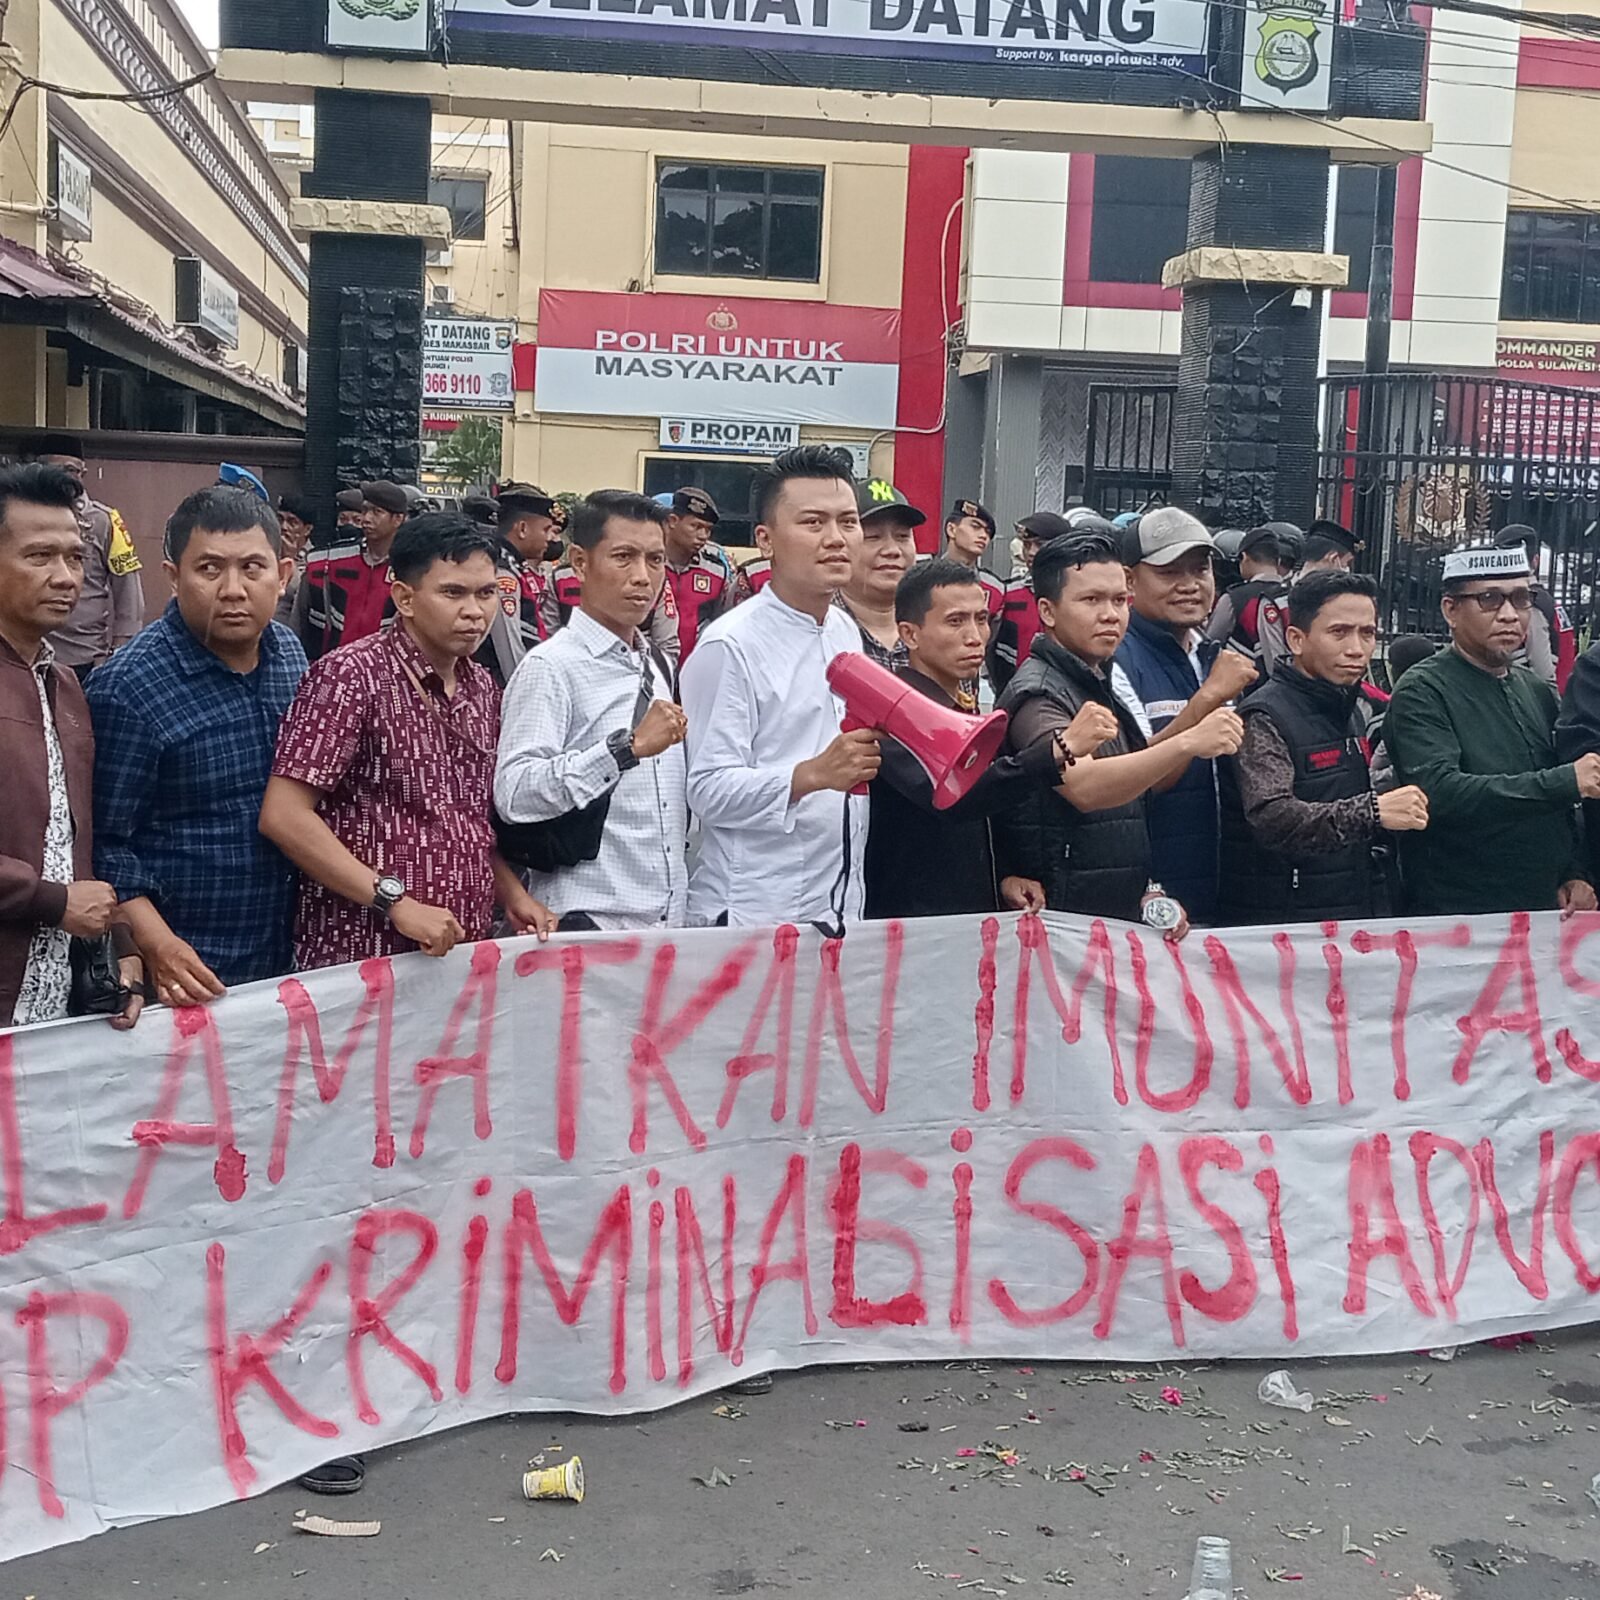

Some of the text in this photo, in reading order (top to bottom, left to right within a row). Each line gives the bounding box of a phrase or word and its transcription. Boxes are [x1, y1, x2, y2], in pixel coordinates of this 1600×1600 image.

[995, 48, 1037, 61] Support
[1059, 51, 1102, 66] karya
[442, 325, 490, 340] DATANG
[442, 340, 490, 351] MAKASSAR
[595, 329, 844, 361] POLRI UNTUK
[1496, 341, 1596, 358] OMMANDER
[595, 356, 844, 387] MASYARAKAT
[1537, 361, 1596, 372] SULAWESI
[424, 372, 481, 395] 366 9110
[690, 422, 792, 444] PROPAM
[0, 1288, 128, 1519] P
